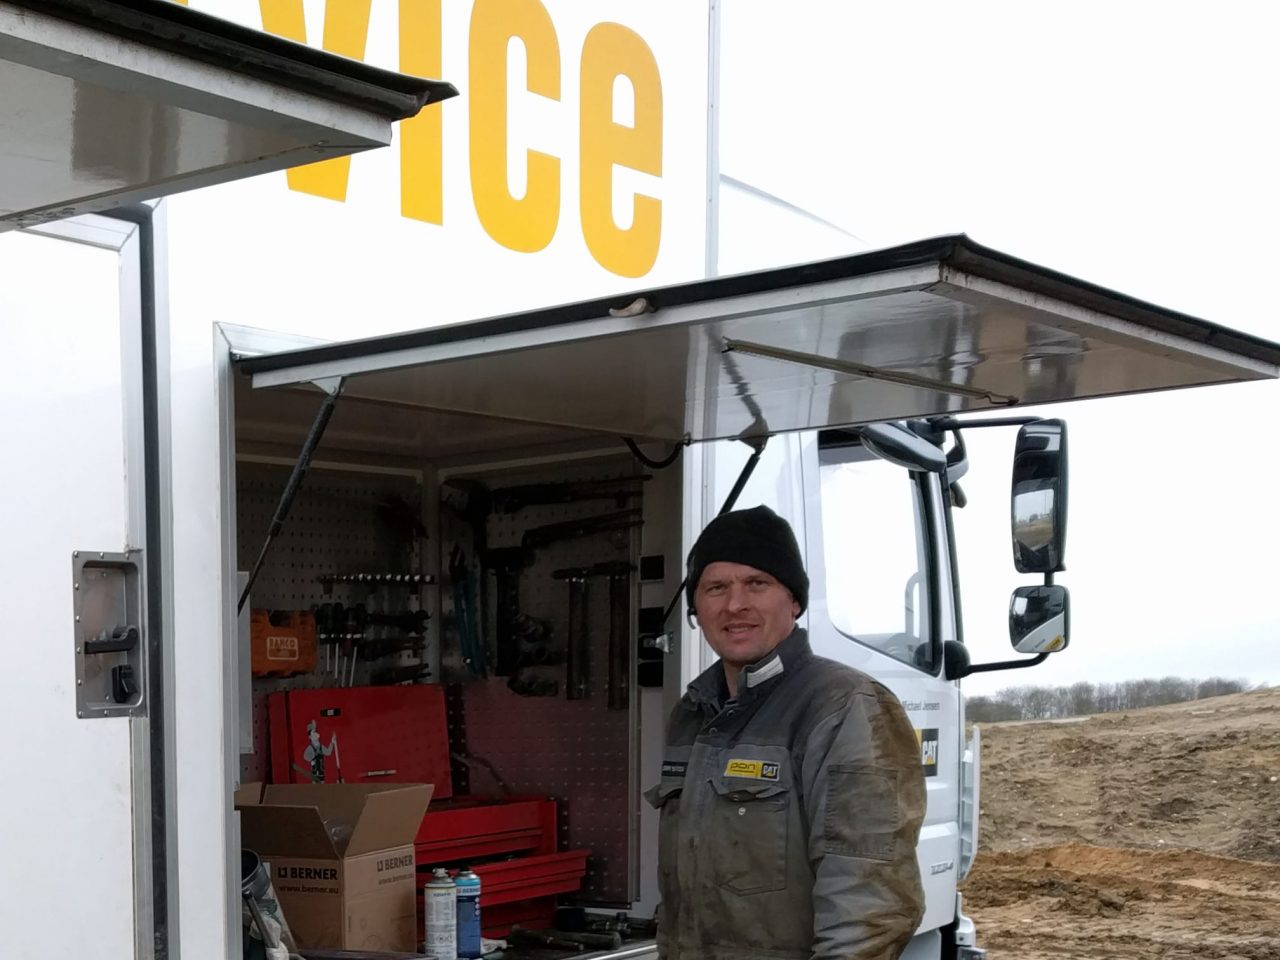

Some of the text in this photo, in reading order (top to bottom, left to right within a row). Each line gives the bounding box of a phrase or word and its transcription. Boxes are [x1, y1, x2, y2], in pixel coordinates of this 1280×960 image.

[922, 741, 937, 765] CAT
[763, 765, 778, 777] CAT
[385, 854, 413, 871] BERNER
[290, 867, 338, 880] BERNER
